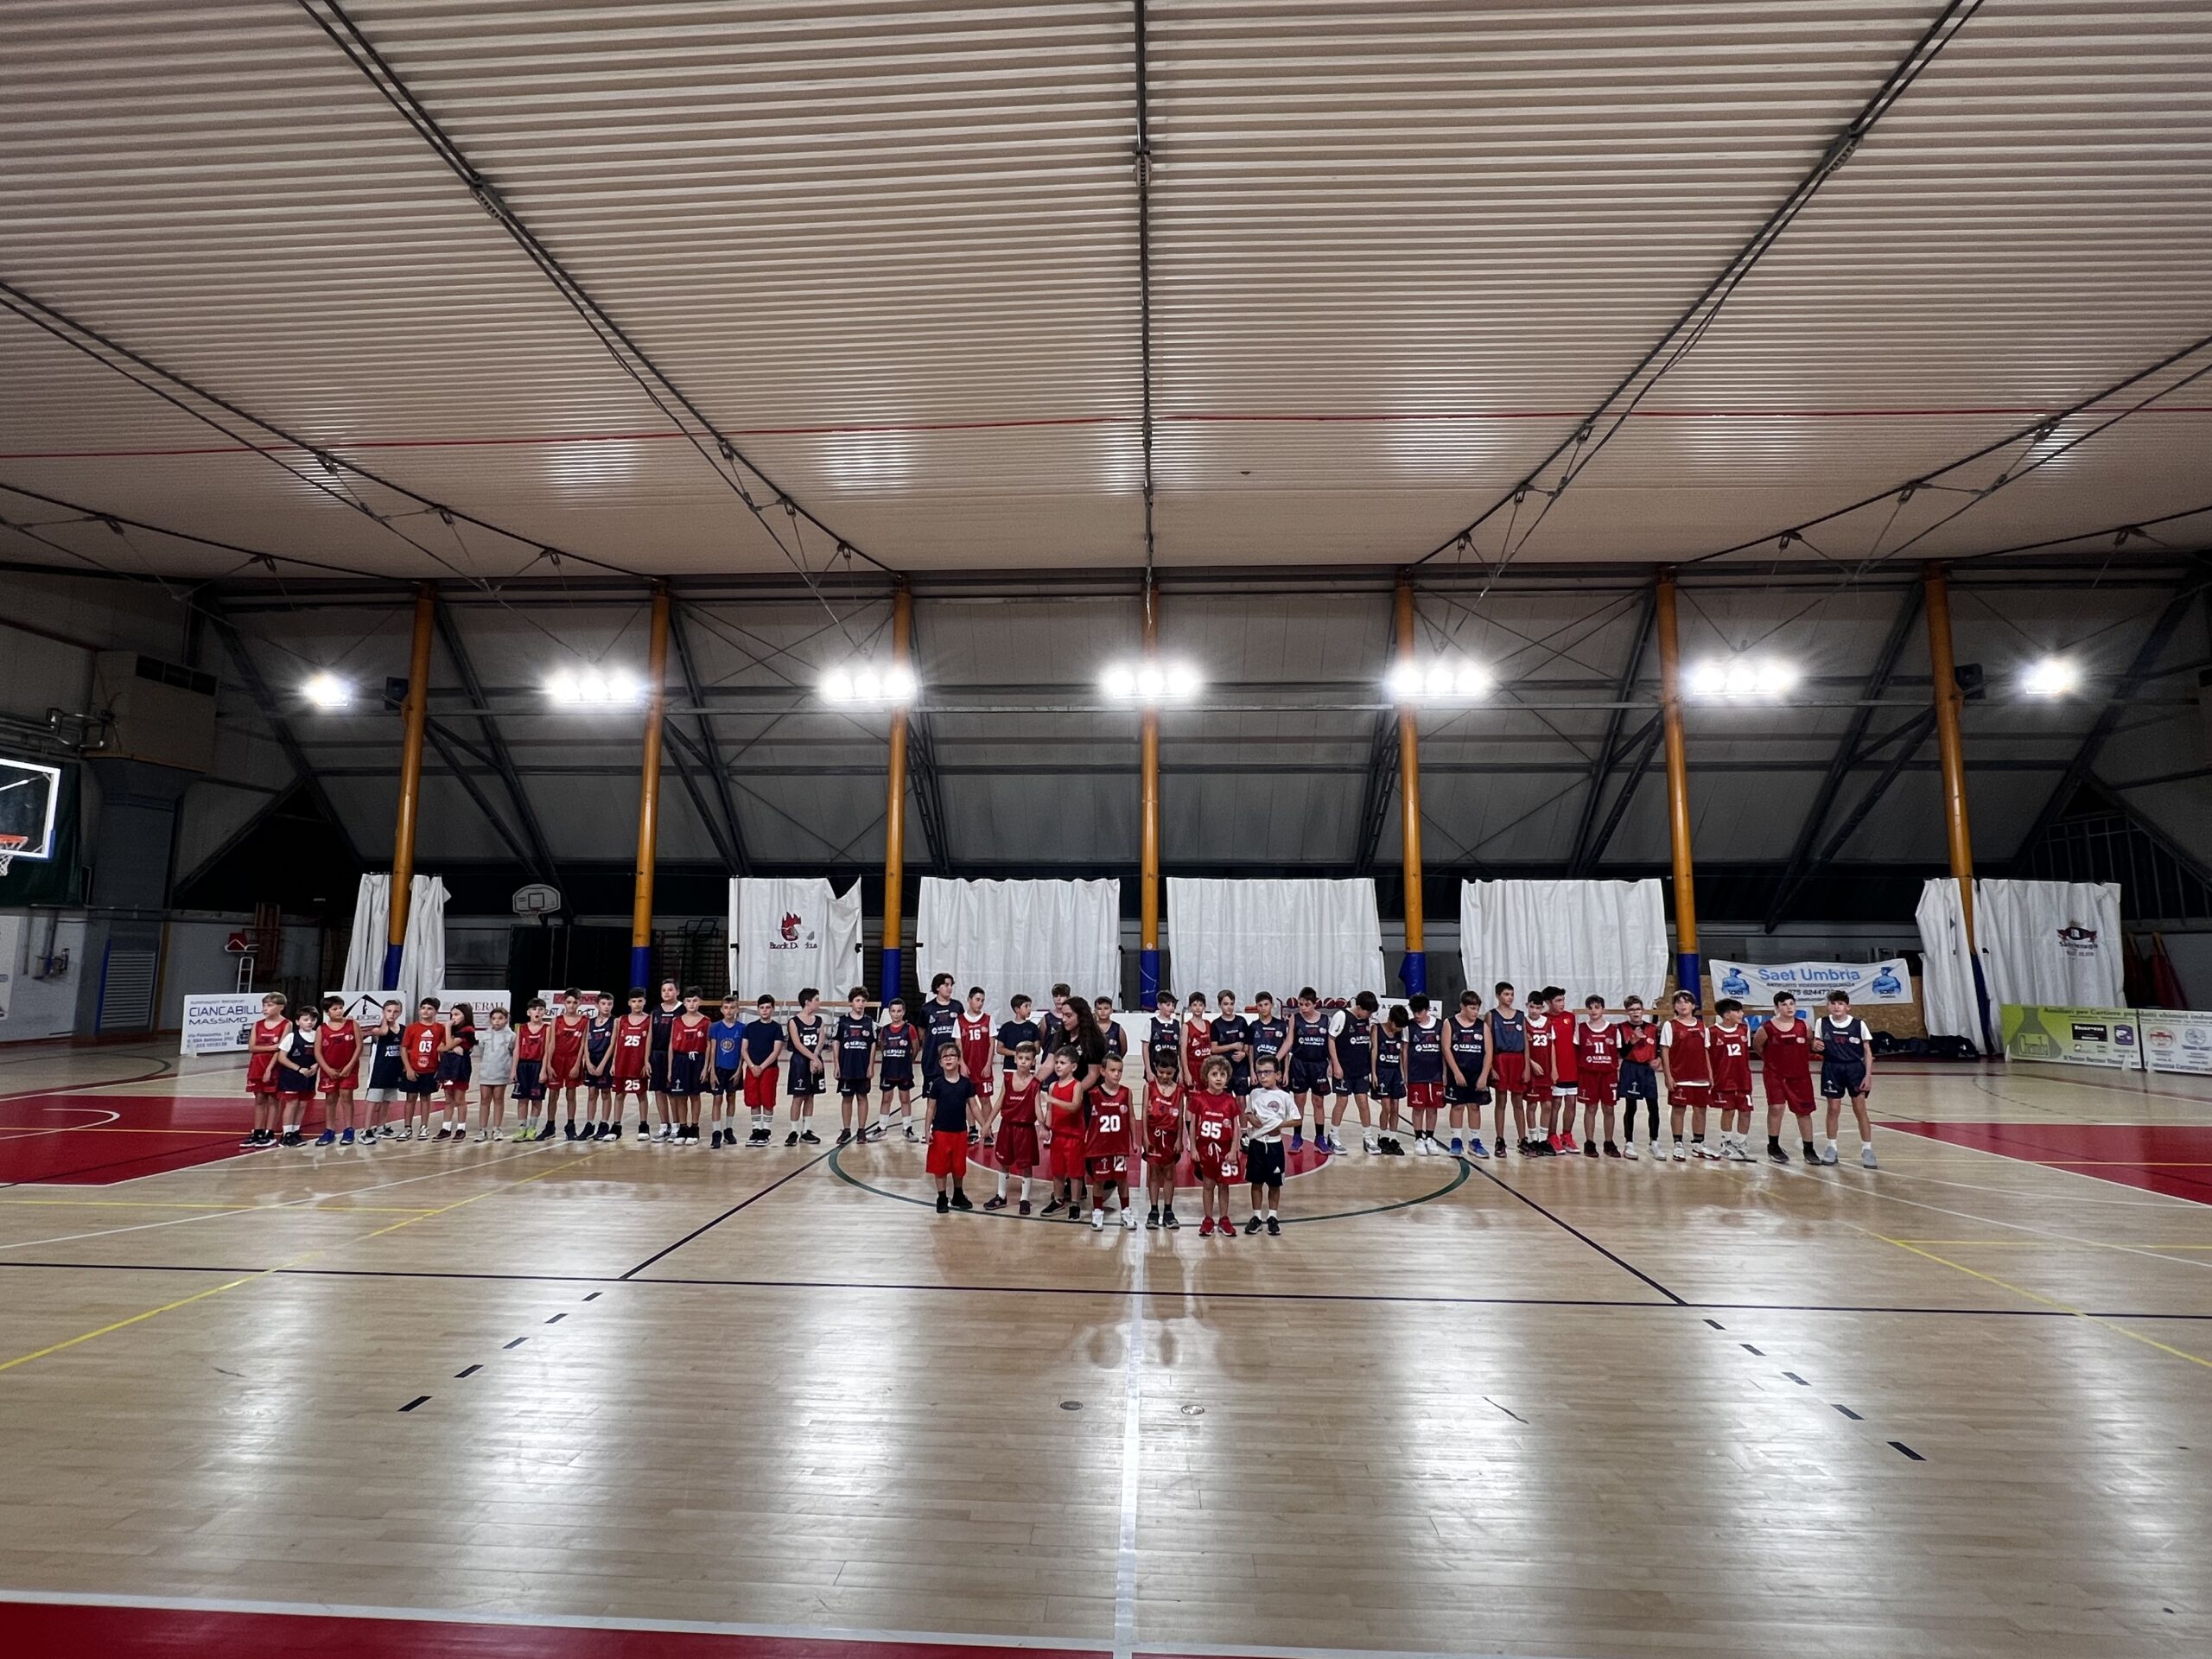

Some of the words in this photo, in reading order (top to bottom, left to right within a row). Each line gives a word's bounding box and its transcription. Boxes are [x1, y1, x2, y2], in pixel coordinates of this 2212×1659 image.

[1758, 969, 1796, 981] Saet
[1800, 968, 1860, 981] Umbria
[189, 1005, 264, 1017] CIANCABILL
[188, 1016, 248, 1026] MASSIMO
[624, 1035, 641, 1046] 25
[803, 1034, 817, 1046] 52
[969, 1029, 982, 1040] 16
[1533, 1033, 1548, 1046] 23
[418, 1040, 432, 1052] 03
[1594, 1041, 1605, 1054] 11
[1726, 1043, 1742, 1056] 12
[625, 1079, 640, 1090] 25
[982, 1082, 993, 1093] 16
[1099, 1115, 1121, 1133] 20
[1200, 1121, 1223, 1140] 95
